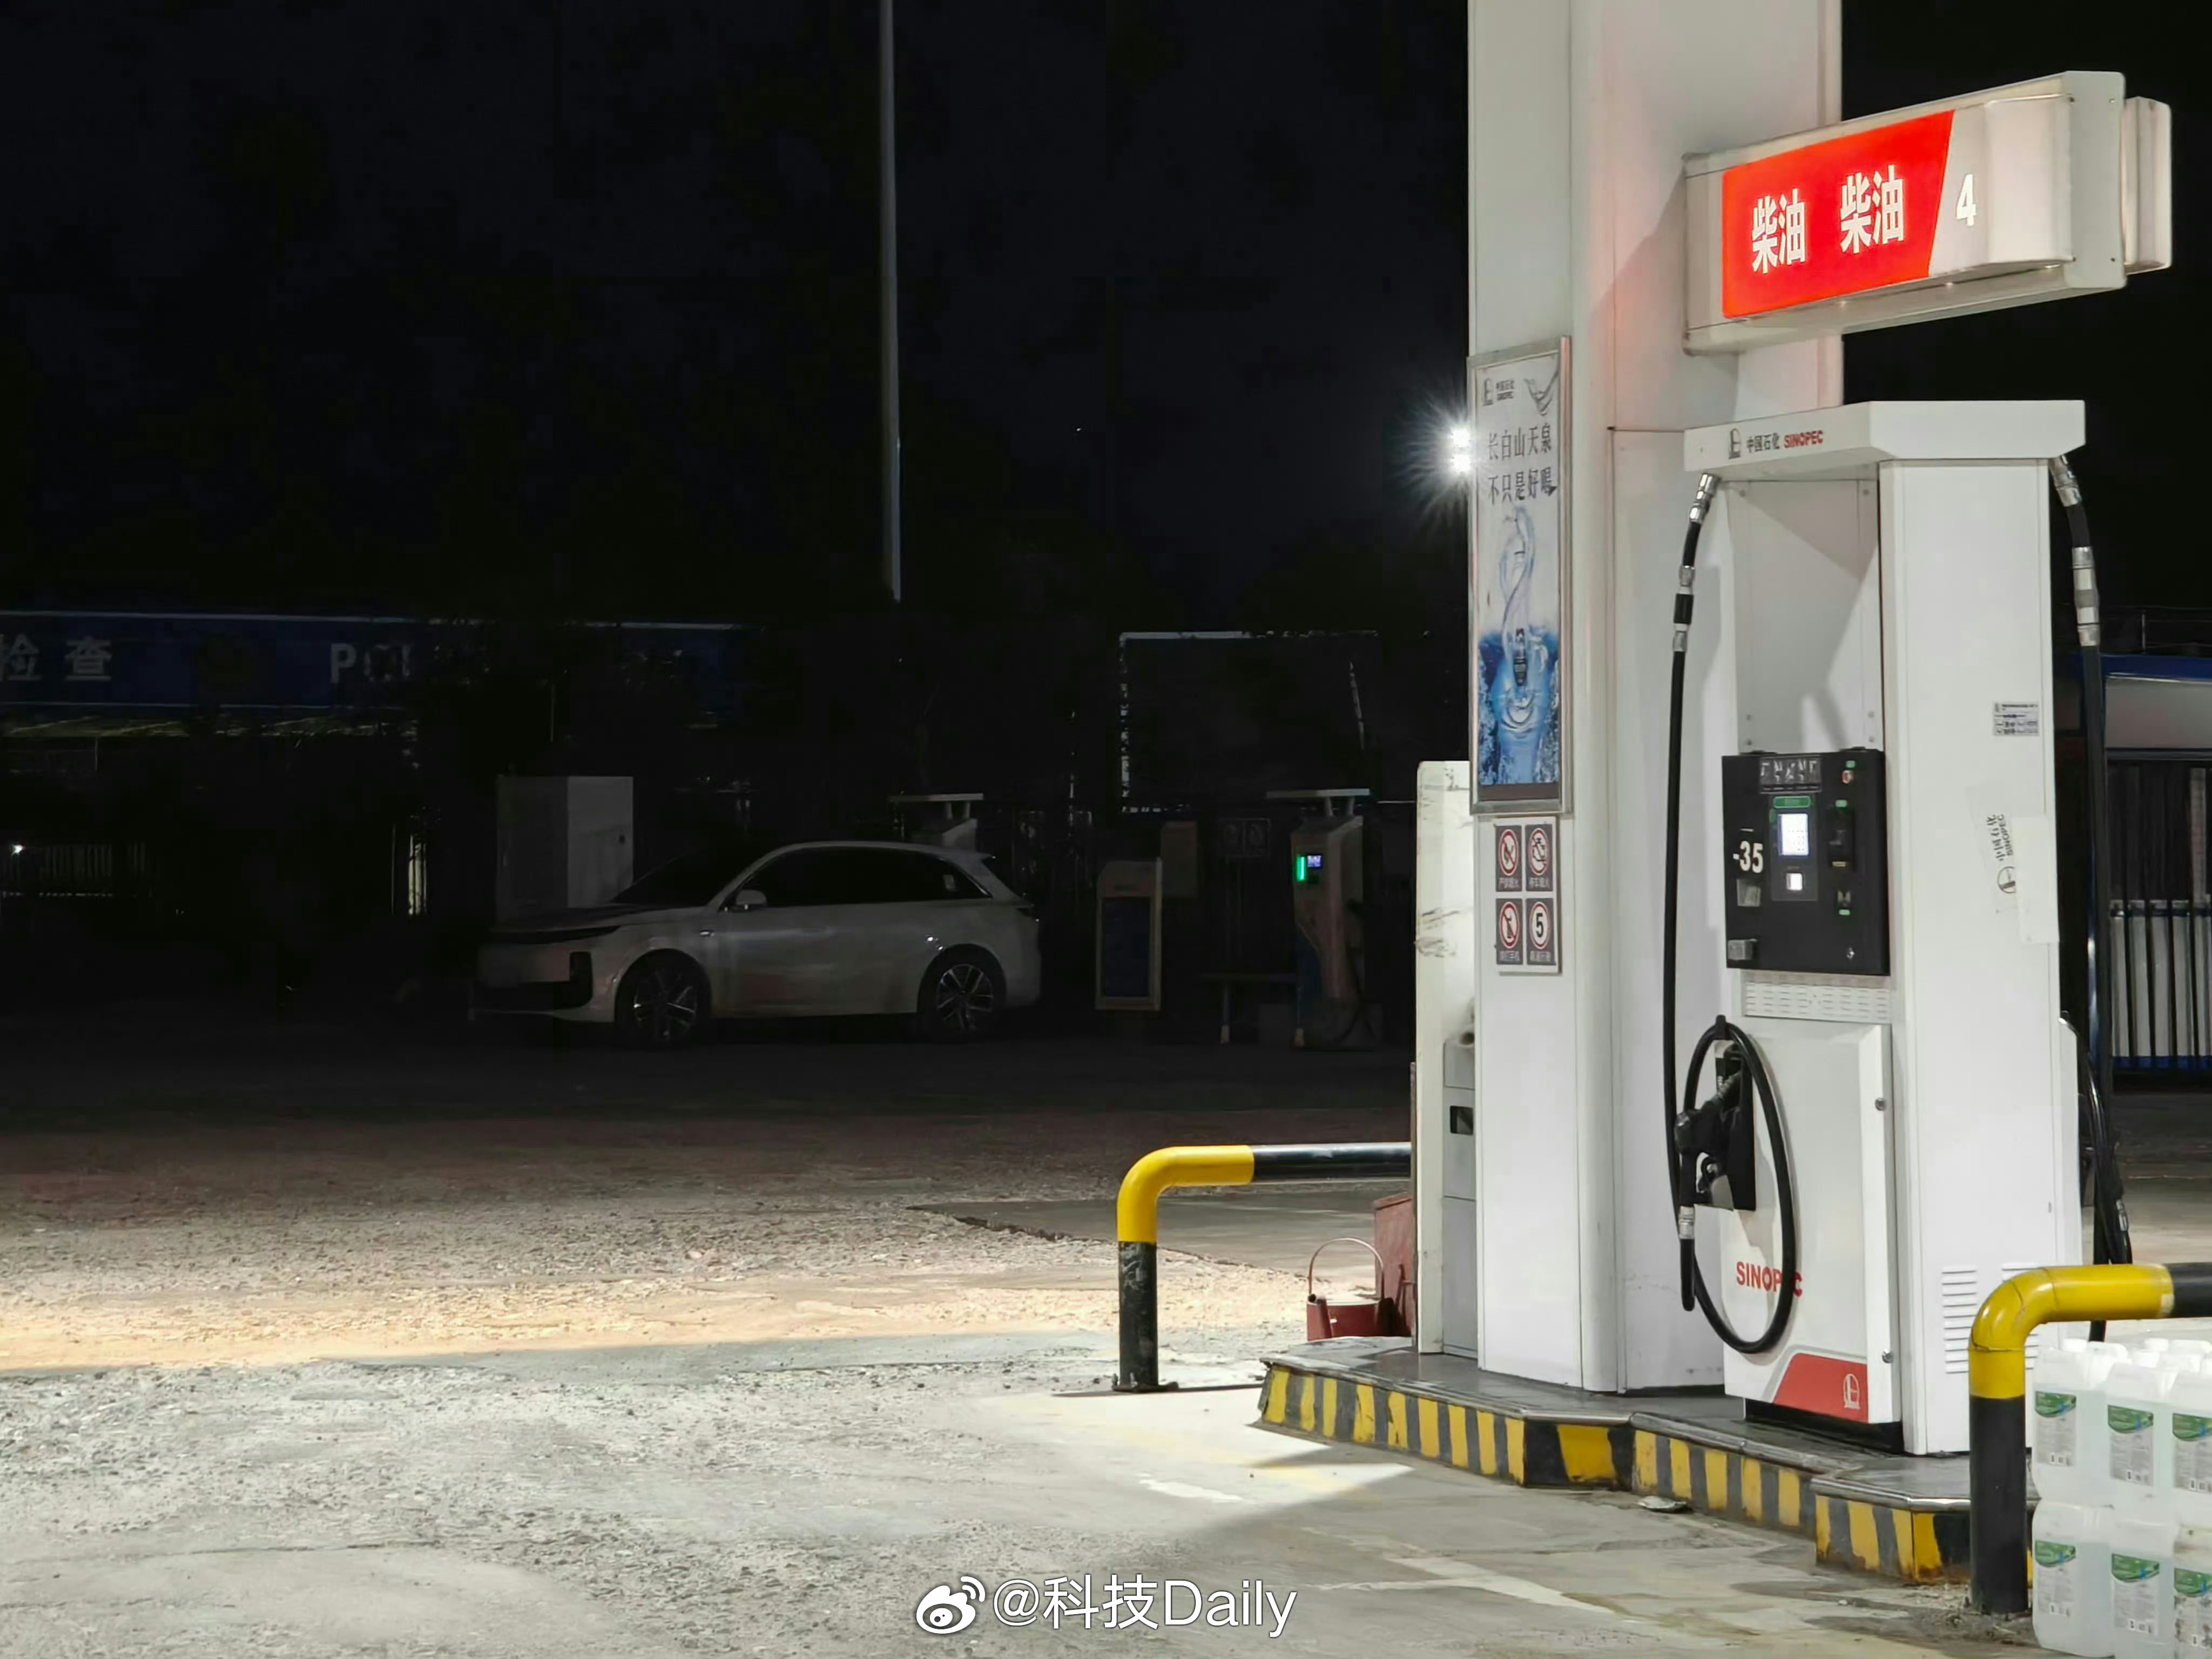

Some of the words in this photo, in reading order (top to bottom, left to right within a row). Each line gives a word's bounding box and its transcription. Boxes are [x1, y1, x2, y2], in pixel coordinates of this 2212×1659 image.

[1956, 173, 1977, 227] 4
[1751, 188, 1806, 274] 柴油
[1840, 164, 1905, 254] 柴油
[1784, 429, 1824, 449] SINOPEC
[1535, 913, 1544, 938] 5
[1736, 1261, 1803, 1297] SINOPC
